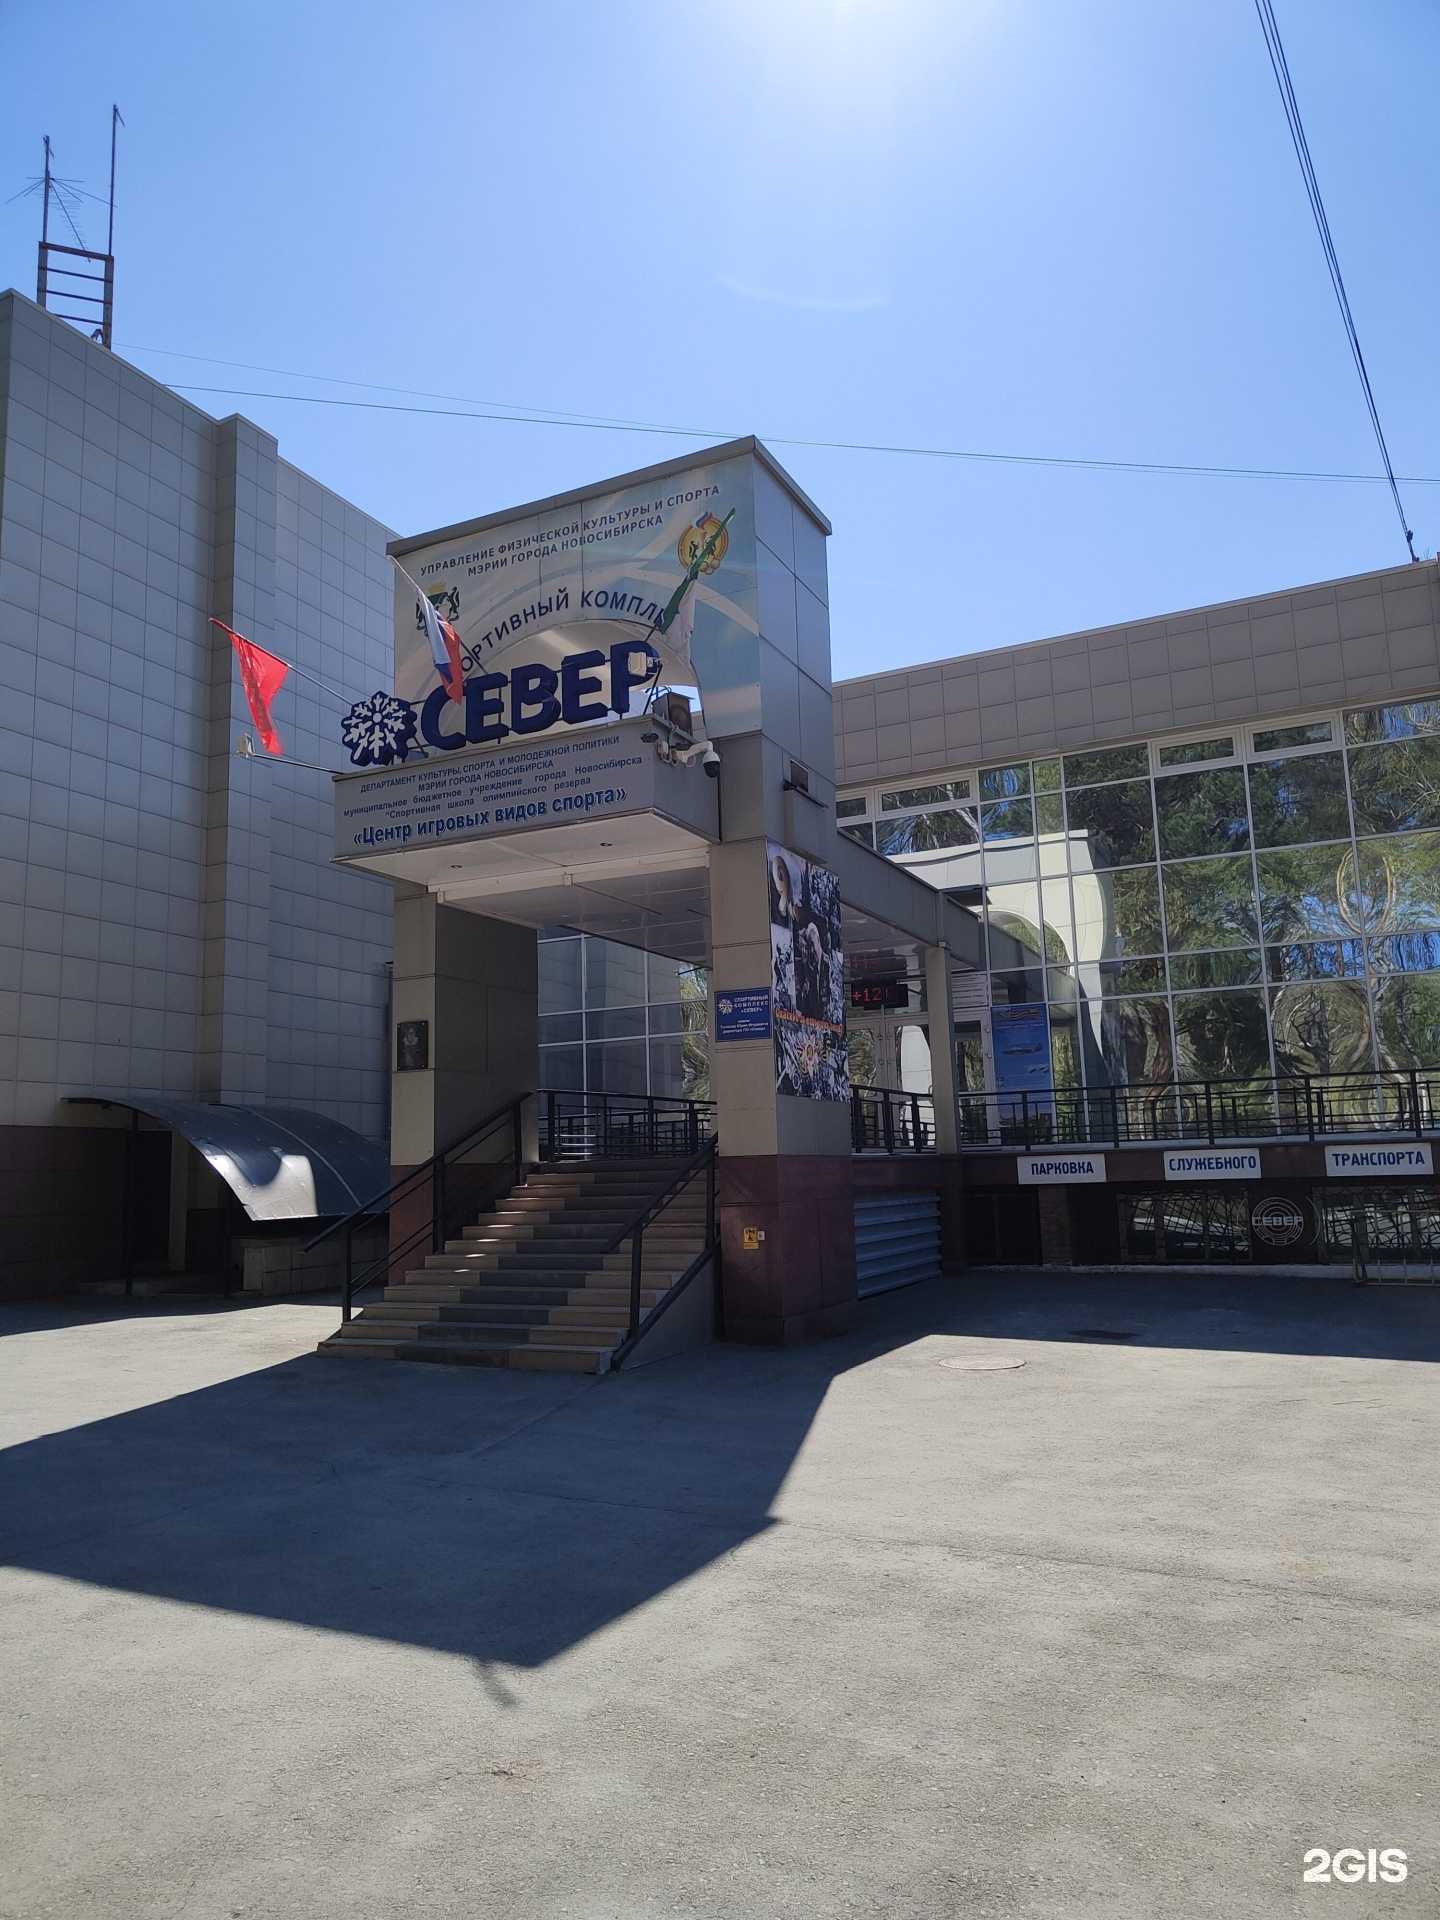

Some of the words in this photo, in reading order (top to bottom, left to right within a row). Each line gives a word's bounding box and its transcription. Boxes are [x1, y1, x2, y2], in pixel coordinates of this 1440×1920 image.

[420, 547, 495, 577] УПРАВЛЕНИЕ
[498, 521, 579, 554] ФИЗИЧЕСКОЙ
[583, 504, 650, 531] КУЛЬТУРЫ
[654, 500, 663, 511] И
[667, 485, 720, 507] СПОРТА
[467, 558, 508, 577] МЭРИИ
[511, 543, 558, 565] ГОРОДА
[561, 514, 663, 551] НОВОСИБИРСКА
[461, 587, 569, 672] ОРТИВНЫЙ
[581, 590, 663, 626] КОМПЛ
[421, 641, 662, 750] СЕВЕР
[343, 799, 408, 818] муниципальное
[413, 790, 462, 804] бюджетное
[469, 778, 522, 796] учреждение
[535, 770, 567, 783] города
[575, 756, 643, 775] Новосибирска
[360, 775, 416, 793] ДЕПАРТАМЕНТ
[463, 760, 496, 773] СПОРТА
[499, 756, 506, 766] И
[507, 744, 570, 764] МОЛОДЕЖНОЙ
[572, 735, 620, 752] ПОЛИТИКИ
[418, 780, 447, 792] МЭРИИ
[449, 774, 482, 787] ГОРОДА
[484, 760, 554, 779] НОВОСИБИРСКА
[448, 799, 475, 809] школа
[554, 776, 591, 792] резерва
[353, 824, 412, 846] «Центр
[417, 811, 490, 836] игровых
[495, 800, 546, 822] видов
[552, 788, 627, 812] спорта»
[1031, 1161, 1094, 1175] ПАРКОВКА
[1169, 1156, 1256, 1171] СЛУЖЕБНОГО
[1332, 1151, 1425, 1166] ТРАНСПОРТА
[1252, 1216, 1303, 1226] СЕВЕР
